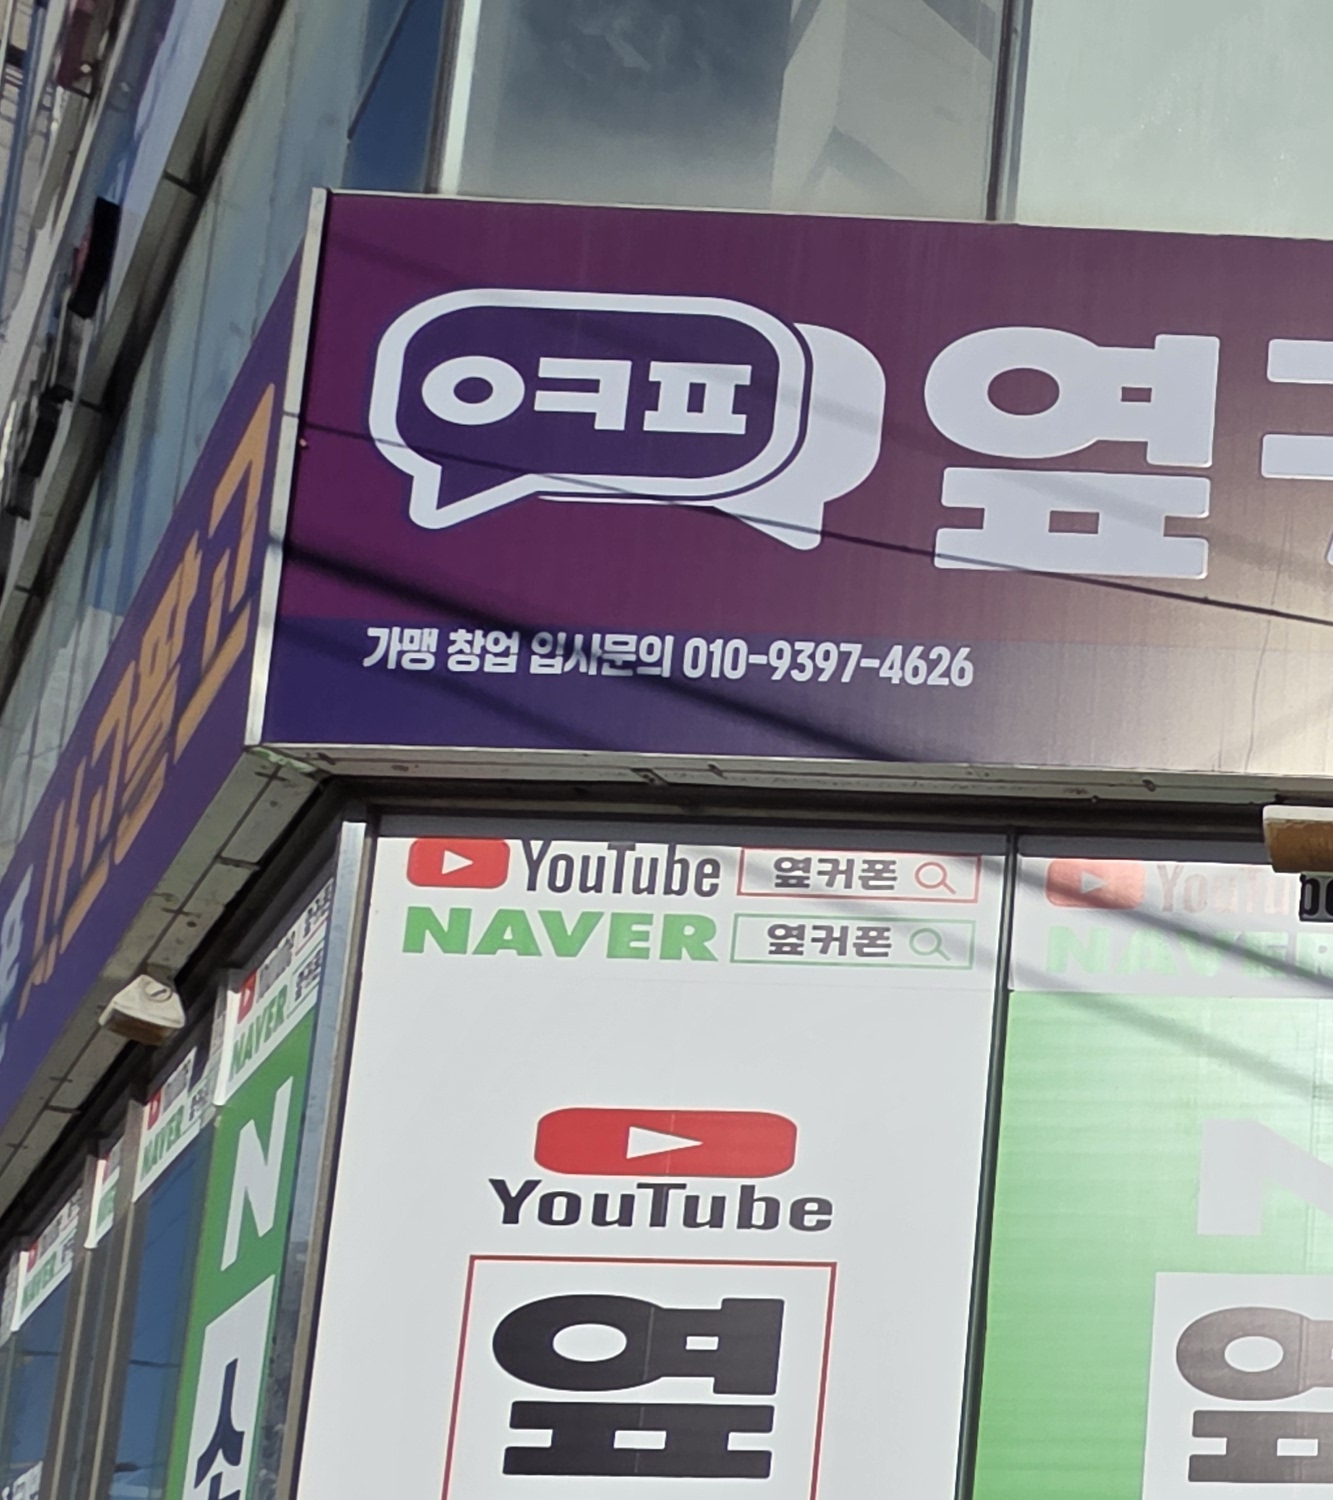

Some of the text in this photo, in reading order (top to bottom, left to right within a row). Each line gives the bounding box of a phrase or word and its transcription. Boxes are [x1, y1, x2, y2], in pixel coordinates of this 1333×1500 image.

[362, 627, 974, 687] 가맹 창업 입사문의 010-9397-4626
[520, 840, 899, 898] YouTube 옆커폰
[402, 906, 893, 962] NAVER 옆커폰
[220, 1076, 294, 1272] N
[488, 1178, 833, 1232] YouTube
